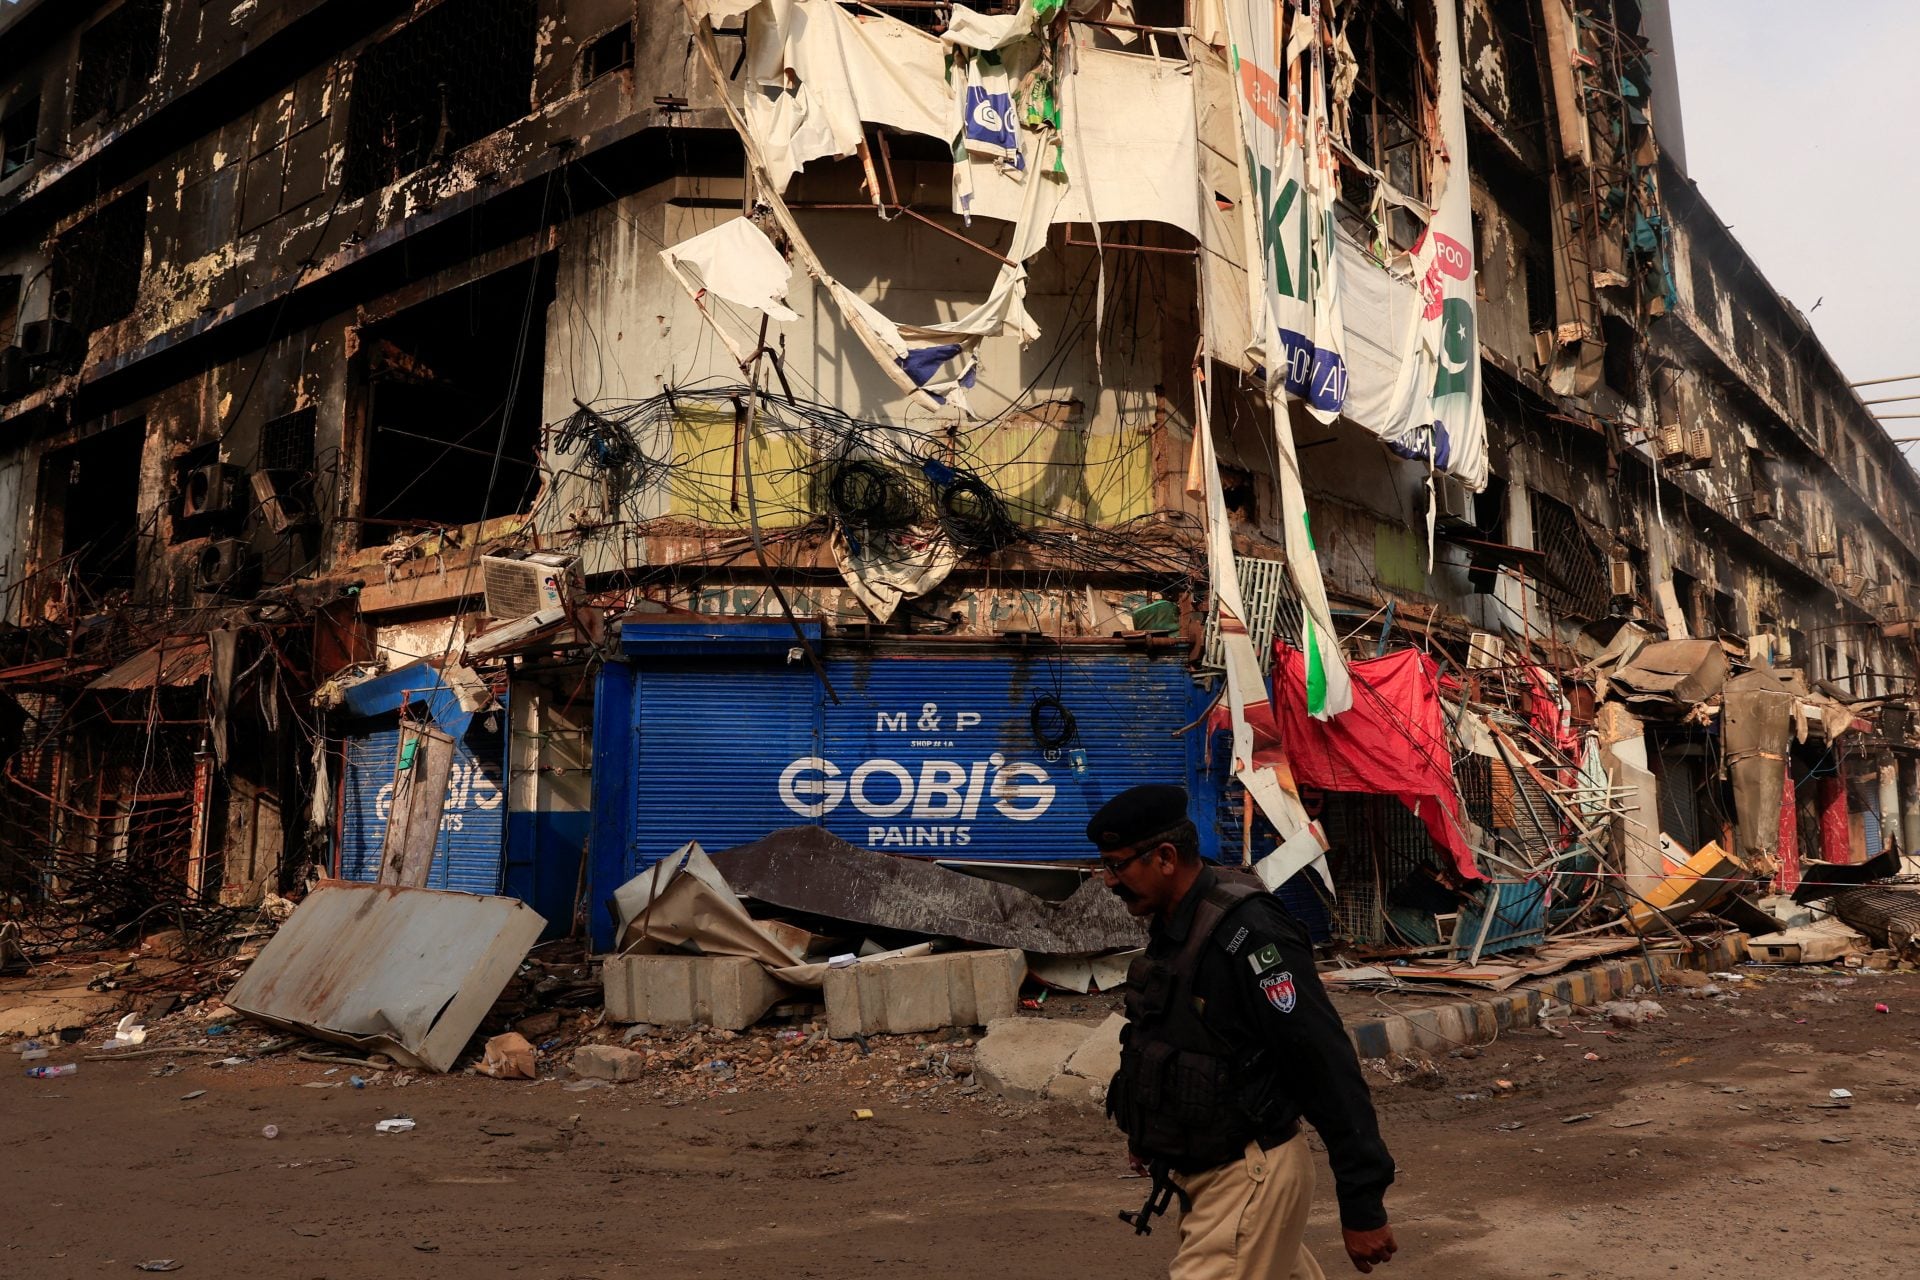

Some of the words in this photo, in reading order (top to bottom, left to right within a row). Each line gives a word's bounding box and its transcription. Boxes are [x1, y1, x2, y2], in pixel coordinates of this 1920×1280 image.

[876, 712, 907, 731] M
[917, 703, 940, 731] &
[956, 712, 982, 731] P
[868, 826, 971, 846] PAINTS
[1263, 974, 1289, 988] POLICE
